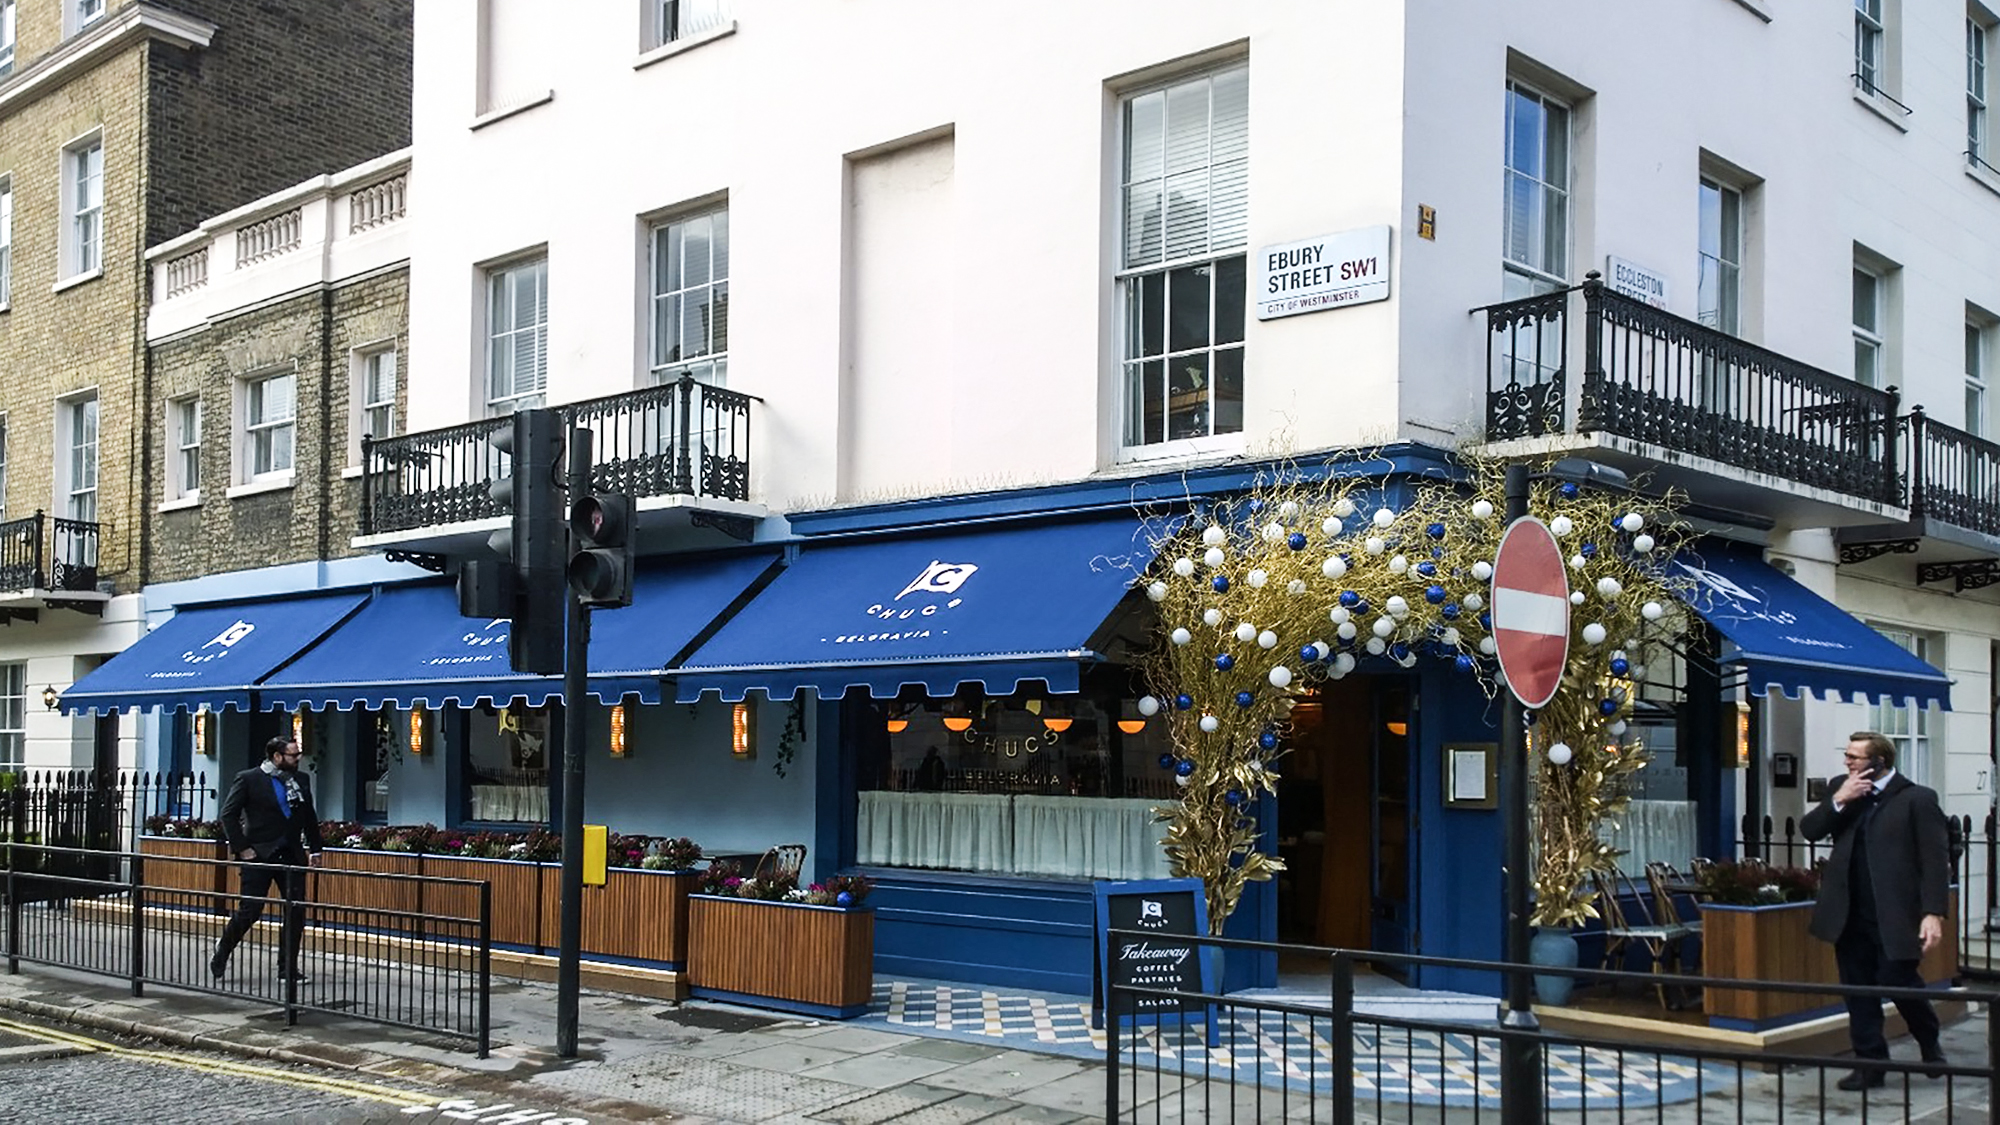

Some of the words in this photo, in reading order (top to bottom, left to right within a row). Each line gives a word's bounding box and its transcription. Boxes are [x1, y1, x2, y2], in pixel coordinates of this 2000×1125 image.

[1268, 244, 1324, 272] EBURY
[1268, 265, 1334, 293] STREET
[1341, 257, 1377, 280] SW1
[1617, 264, 1663, 297] ECCLESTON
[1267, 303, 1285, 314] CITY
[1288, 301, 1298, 310] OF
[1300, 290, 1360, 308] WESTMINSTER
[930, 568, 963, 586] C
[835, 630, 930, 643] BELGRAVIA
[964, 728, 1059, 757] CHUCS
[966, 771, 1060, 785] BELGRAVIA
[1148, 903, 1157, 913] C
[1137, 918, 1169, 928] CHUCS
[1119, 942, 1190, 964] Takeaway
[1136, 964, 1175, 972] COFFEE
[1131, 975, 1182, 984] PASTRIES
[1138, 998, 1180, 1007] SALADS
